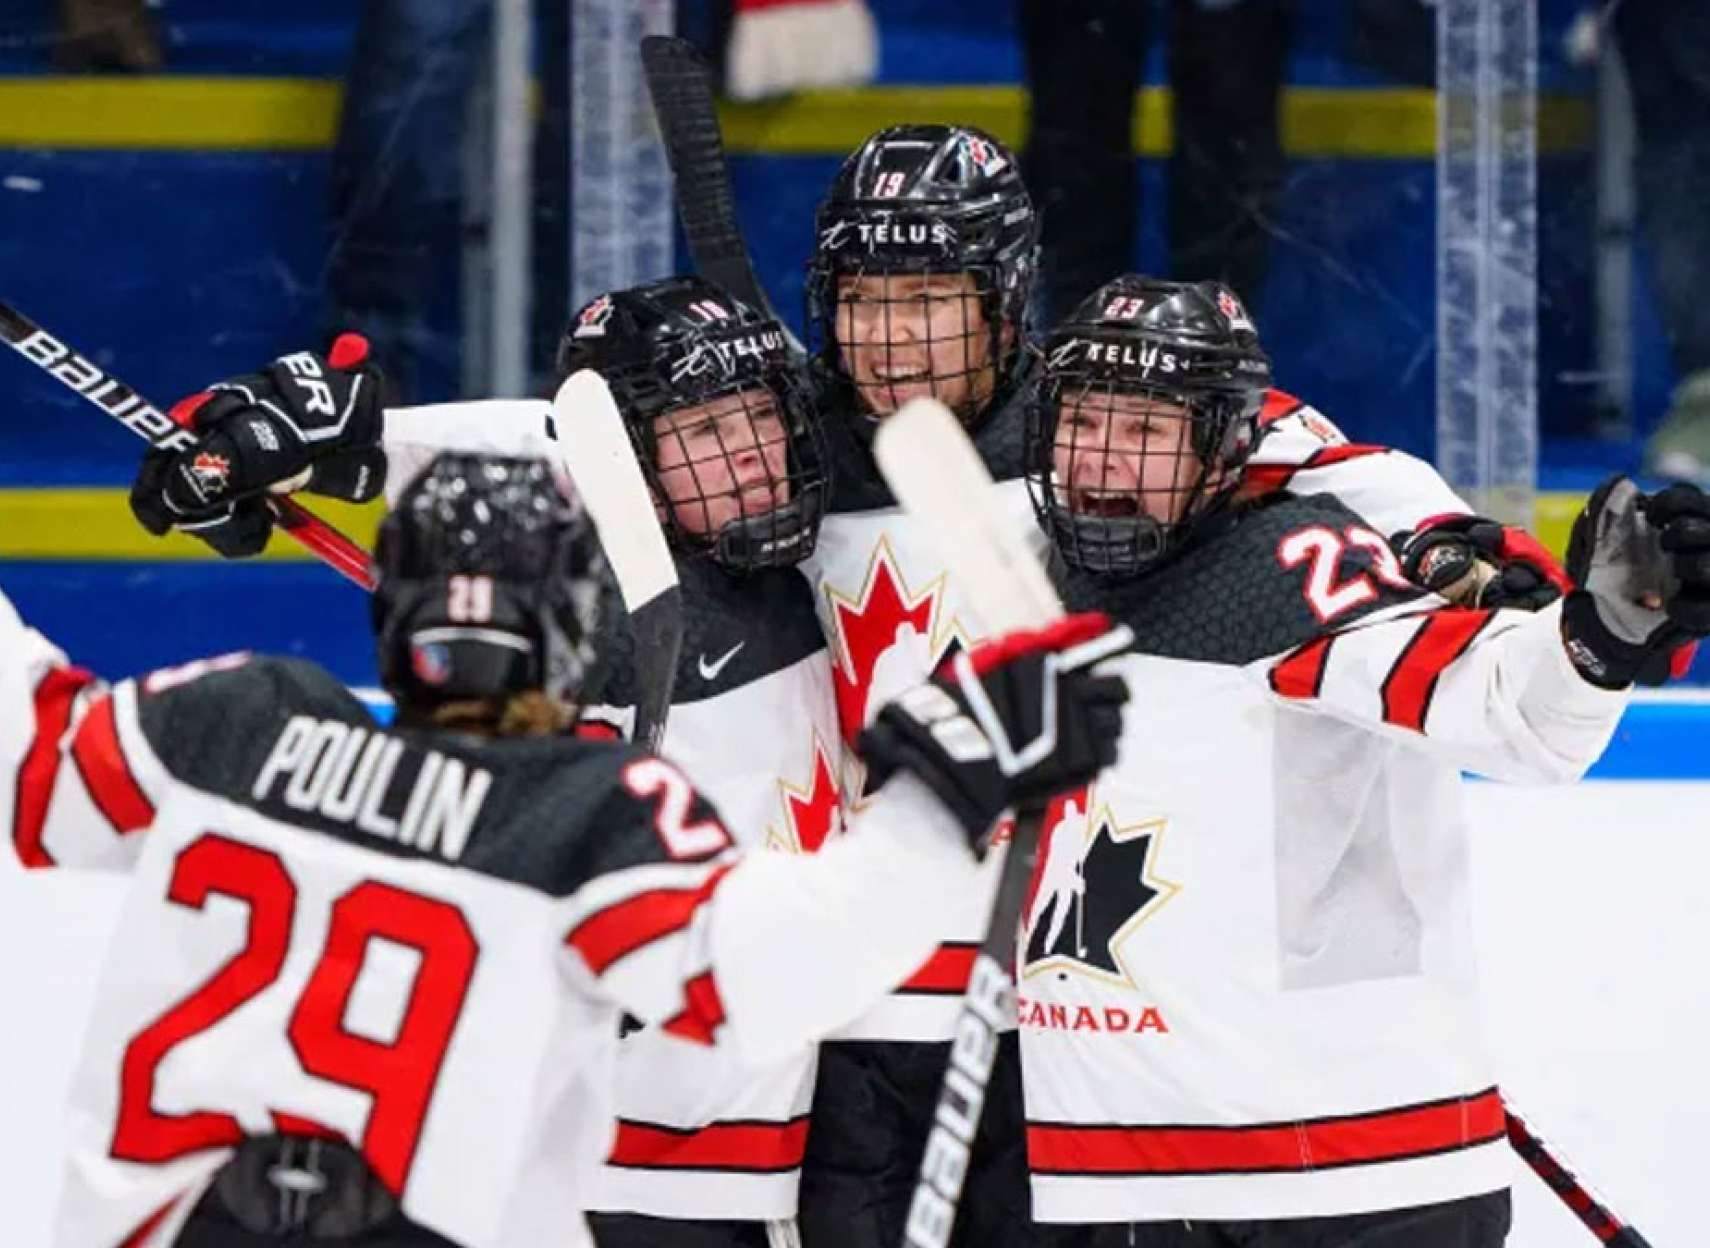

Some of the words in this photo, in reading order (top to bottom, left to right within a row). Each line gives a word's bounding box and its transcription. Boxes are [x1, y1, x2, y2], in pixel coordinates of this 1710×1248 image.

[873, 171, 906, 199] 19
[858, 224, 948, 245] TELUS
[1103, 296, 1145, 320] 23
[1085, 342, 1177, 373] TELUS
[252, 714, 494, 862] POULIN
[622, 753, 734, 861] 2
[108, 831, 481, 1200] 29
